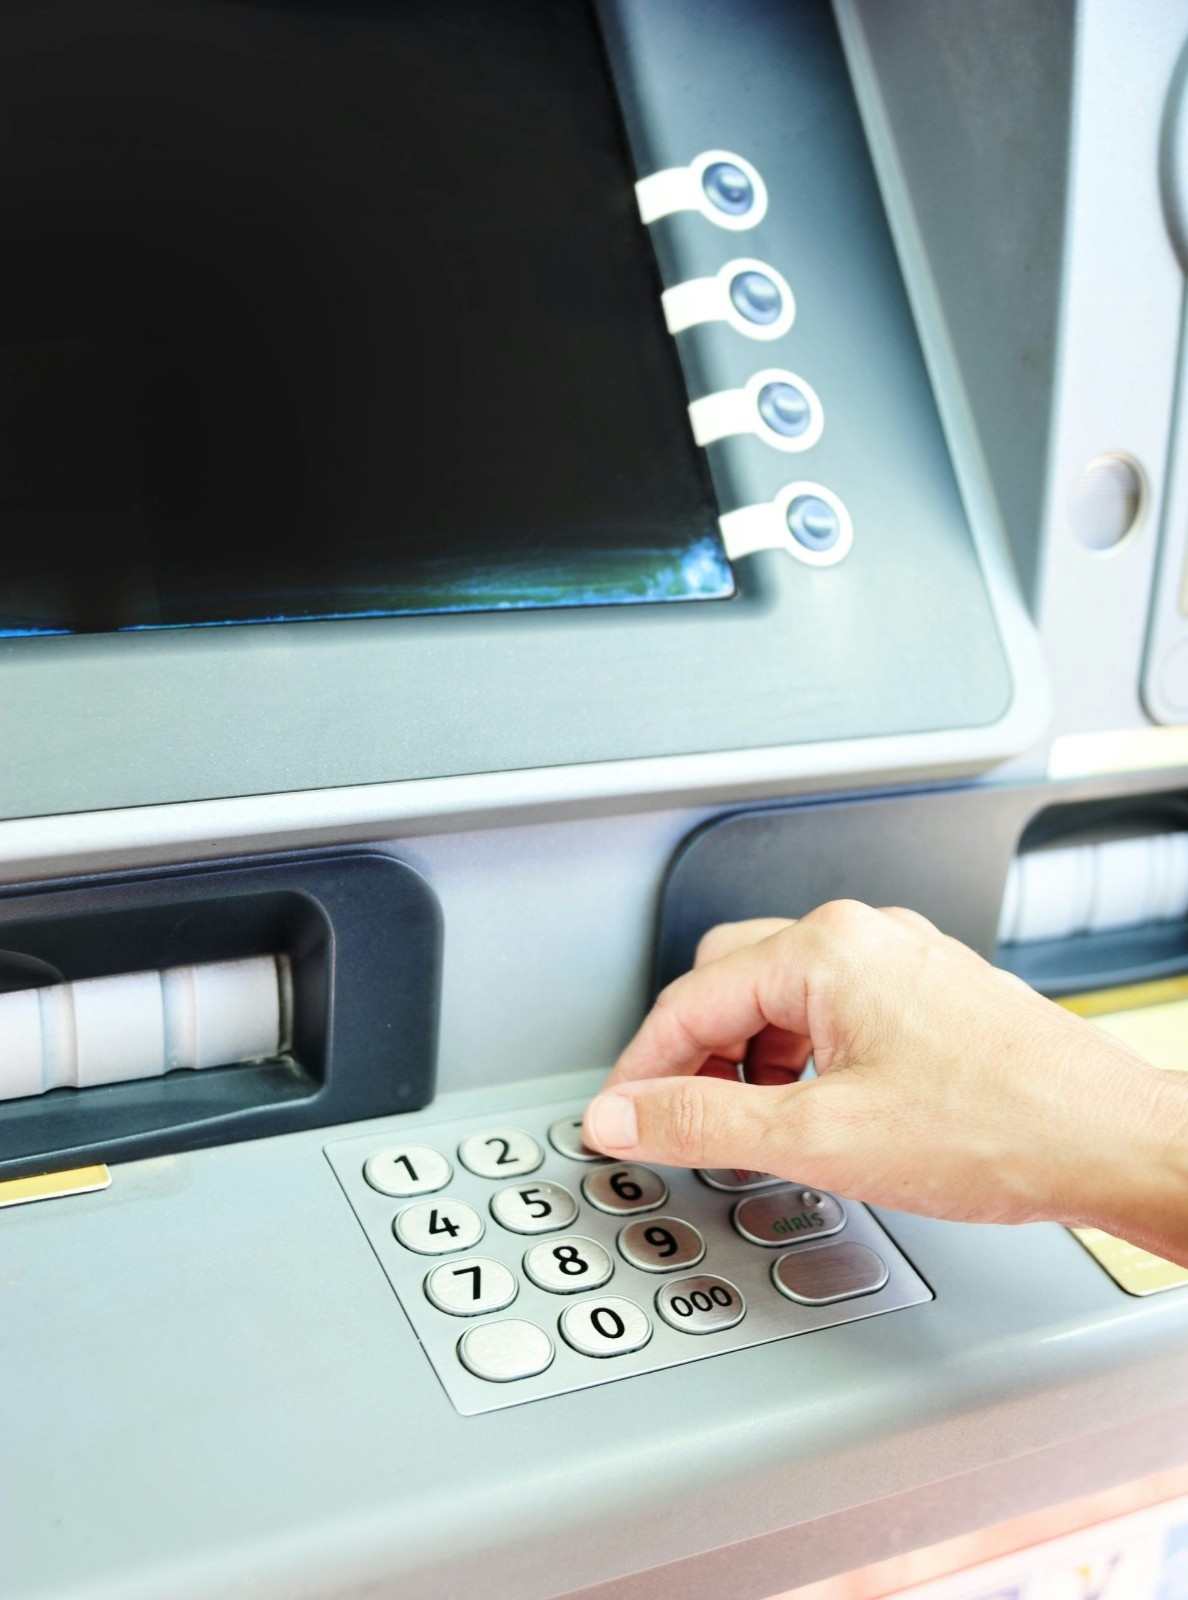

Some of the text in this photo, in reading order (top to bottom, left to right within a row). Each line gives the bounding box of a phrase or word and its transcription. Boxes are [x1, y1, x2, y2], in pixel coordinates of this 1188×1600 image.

[484, 1137, 519, 1166] 2
[393, 1154, 420, 1182] 1
[609, 1171, 644, 1202] 6
[518, 1188, 553, 1219] 5
[428, 1209, 460, 1238] 4
[643, 1226, 679, 1258] 9
[552, 1245, 589, 1276] 8
[452, 1265, 482, 1301] 7
[670, 1285, 733, 1317] 000
[589, 1307, 626, 1340] 0
